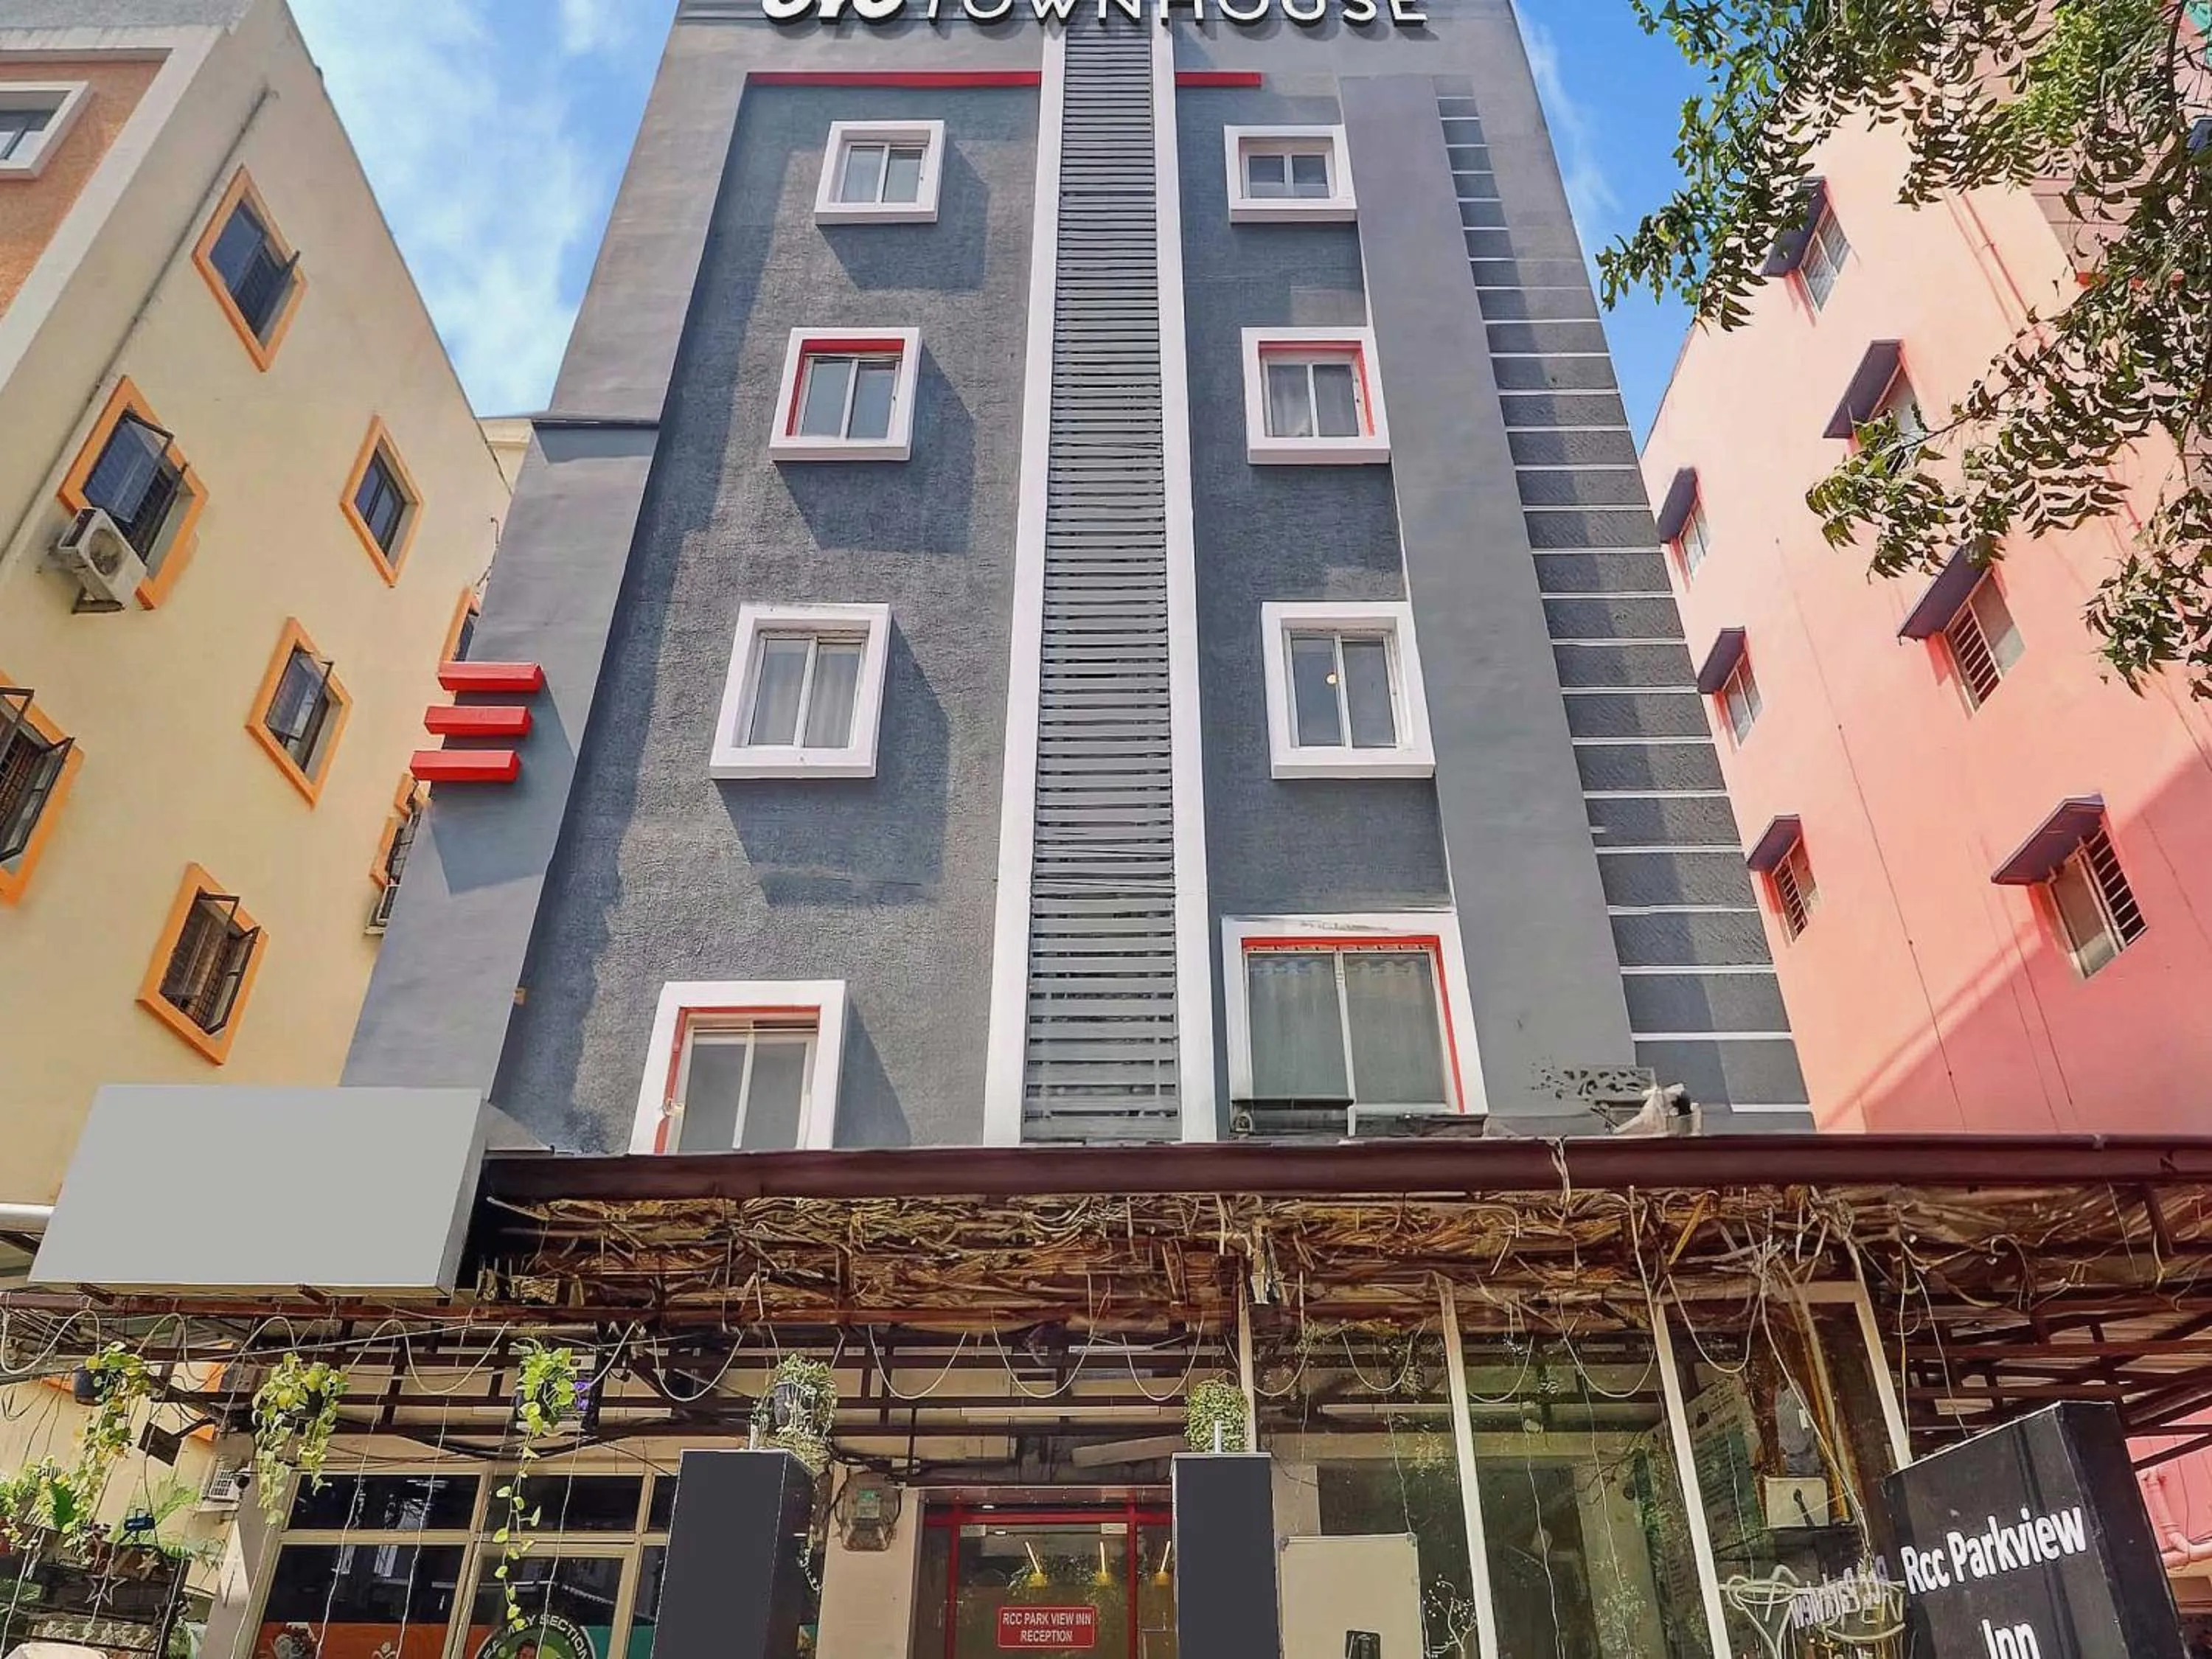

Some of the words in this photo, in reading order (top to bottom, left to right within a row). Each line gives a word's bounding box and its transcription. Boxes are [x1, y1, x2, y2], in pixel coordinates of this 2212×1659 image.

[1900, 1545, 1950, 1595] Rcc
[1946, 1506, 2086, 1583] Parkview
[1003, 1613, 1023, 1625] RCC
[1024, 1612, 1049, 1626] PARK
[1051, 1612, 1074, 1626] VIEW
[1076, 1613, 1091, 1626] INN
[1020, 1630, 1074, 1643] RECEPTION
[1981, 1618, 2042, 1659] Inn
